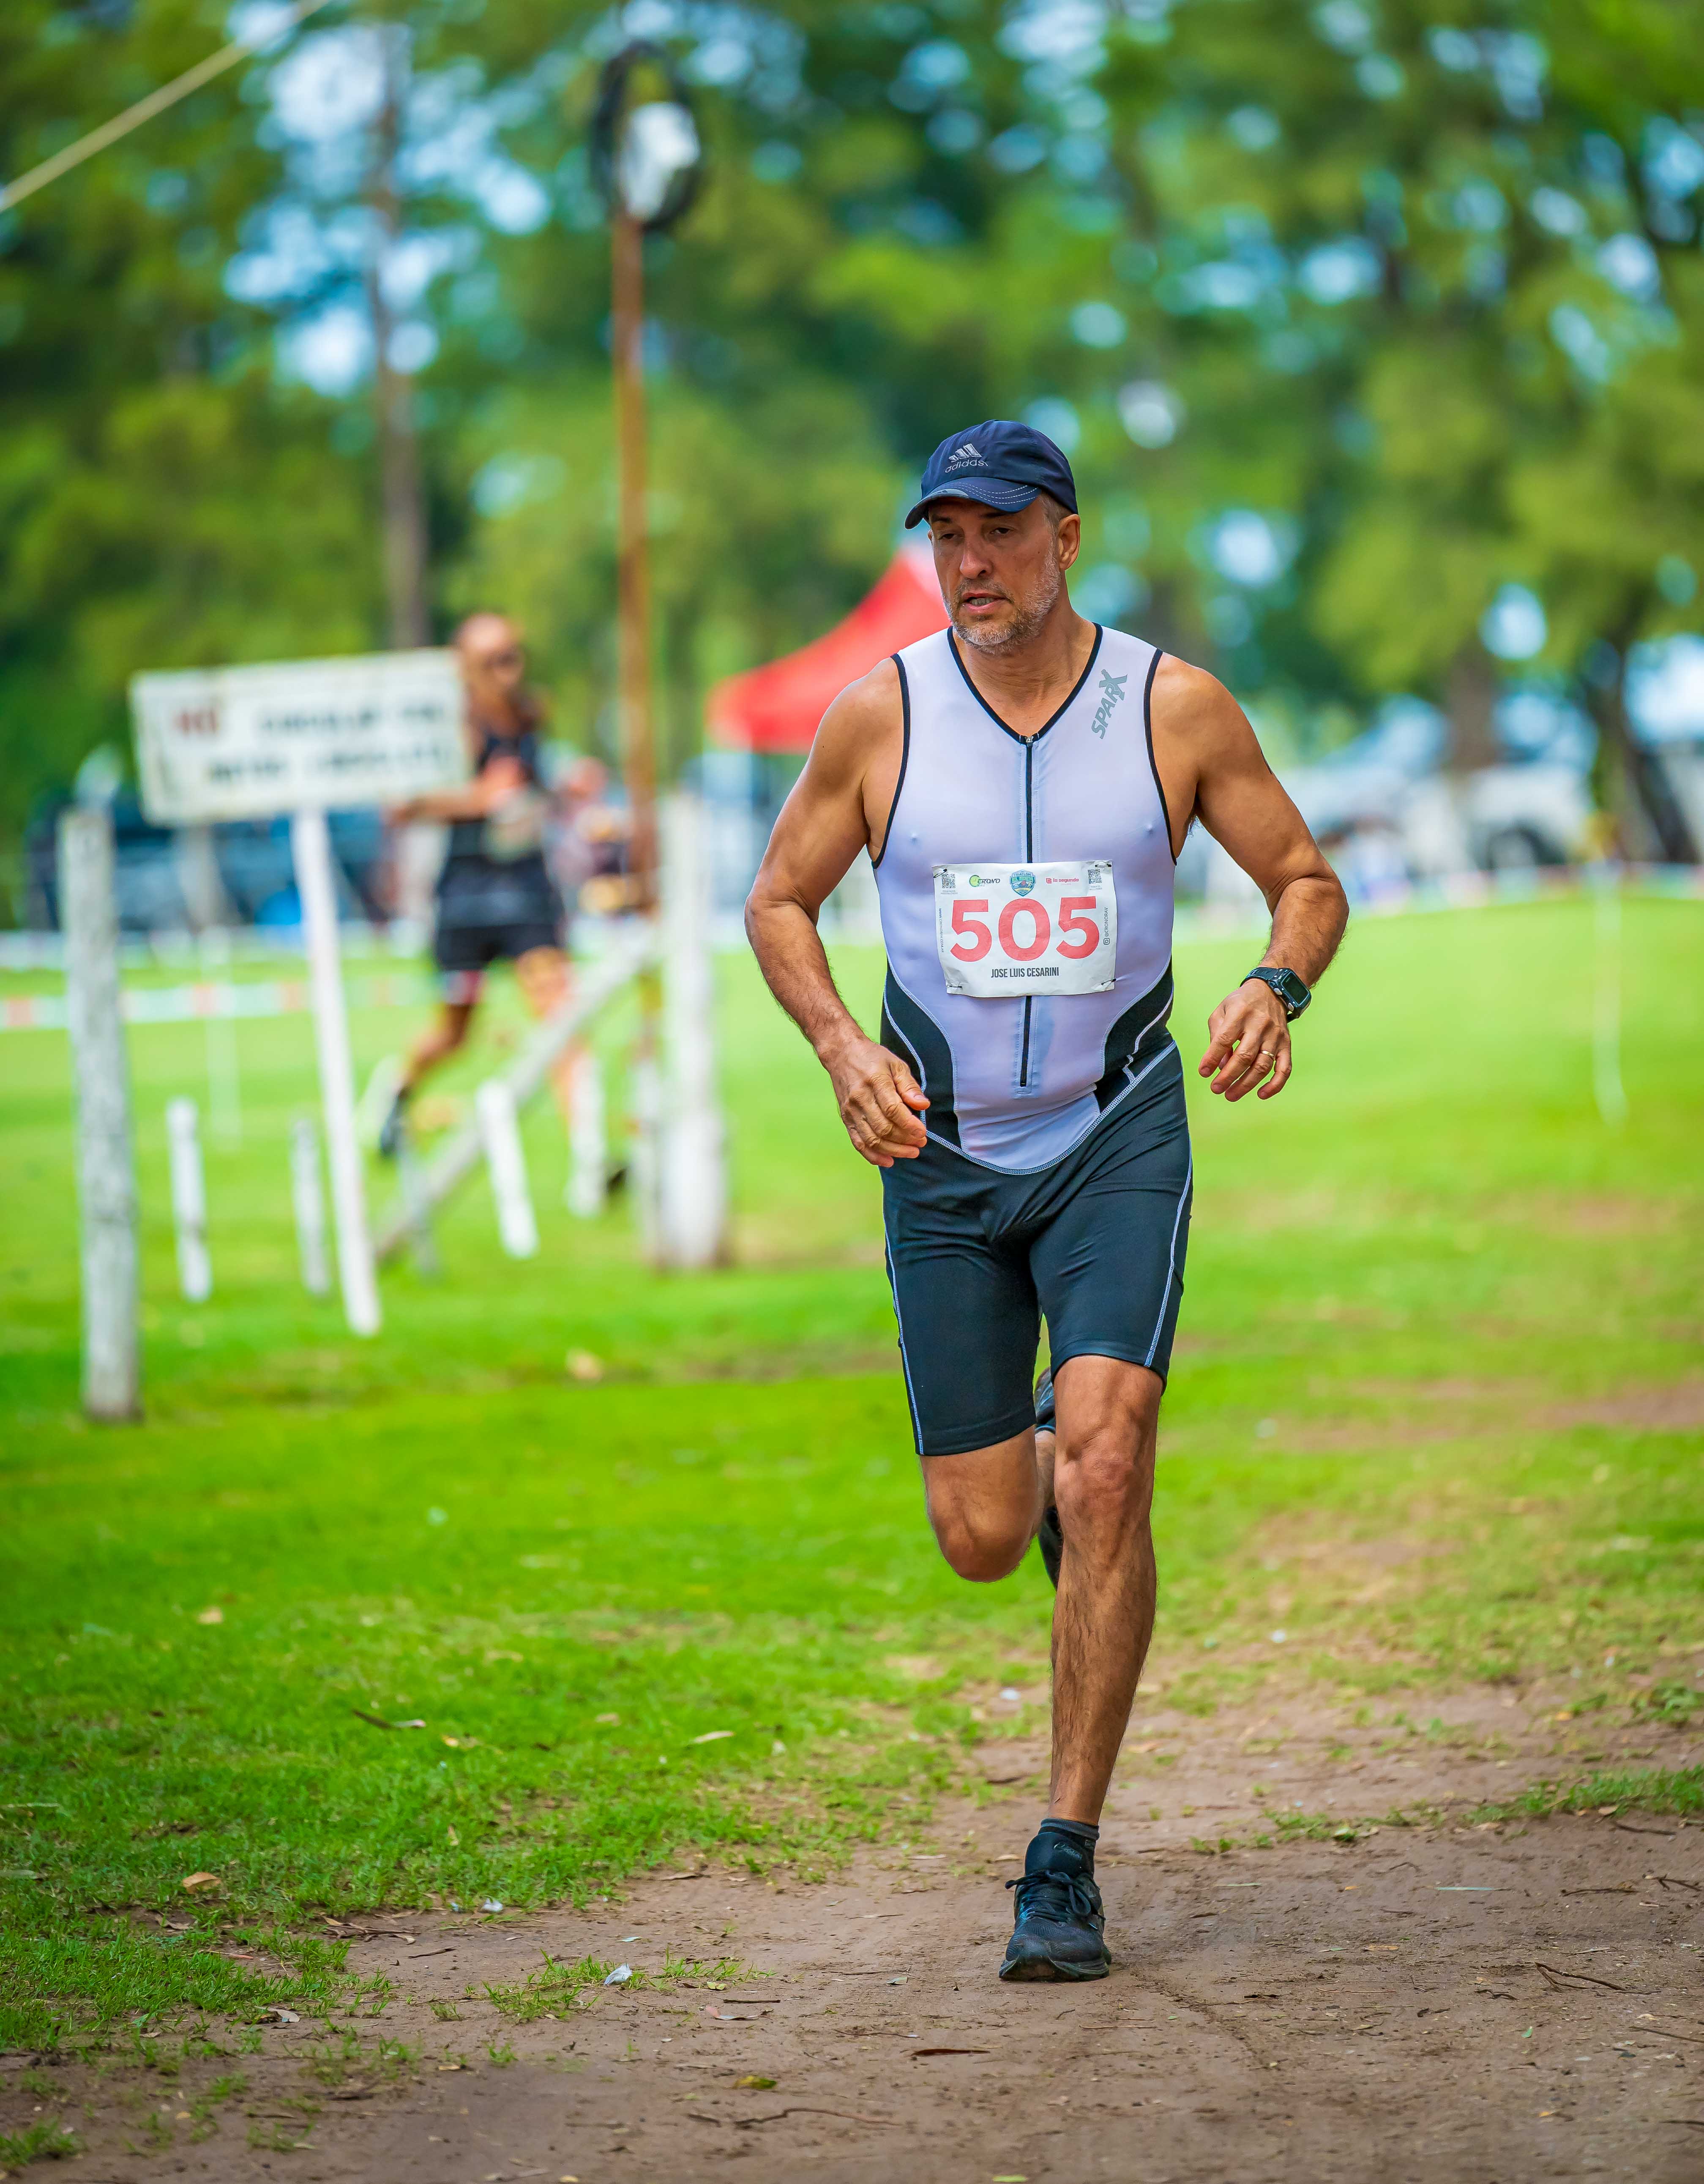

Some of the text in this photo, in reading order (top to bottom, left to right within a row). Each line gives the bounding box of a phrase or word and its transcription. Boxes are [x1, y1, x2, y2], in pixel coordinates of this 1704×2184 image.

[945, 459, 988, 473] adidas
[950, 896, 1100, 962] 505
[991, 967, 1059, 978] JOSE LUIS CESARINI
